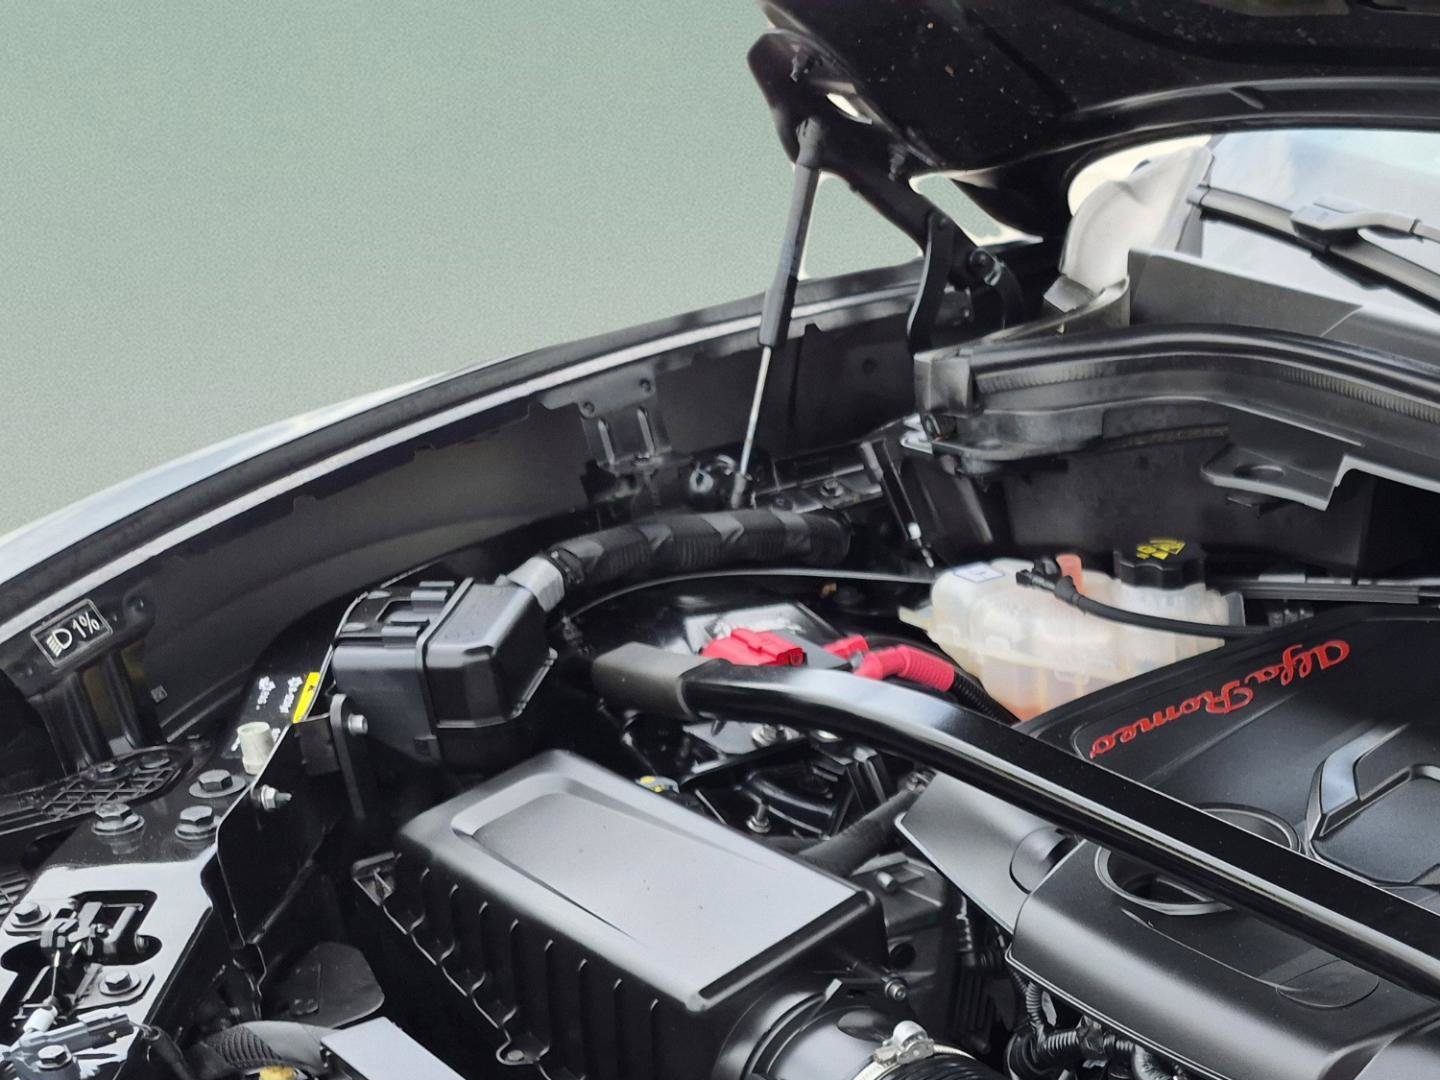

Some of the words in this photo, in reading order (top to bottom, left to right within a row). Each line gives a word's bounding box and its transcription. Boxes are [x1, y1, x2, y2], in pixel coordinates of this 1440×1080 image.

[72, 611, 100, 638] 1%
[1245, 640, 1351, 686] Alfa
[1090, 682, 1254, 759] Romeo
